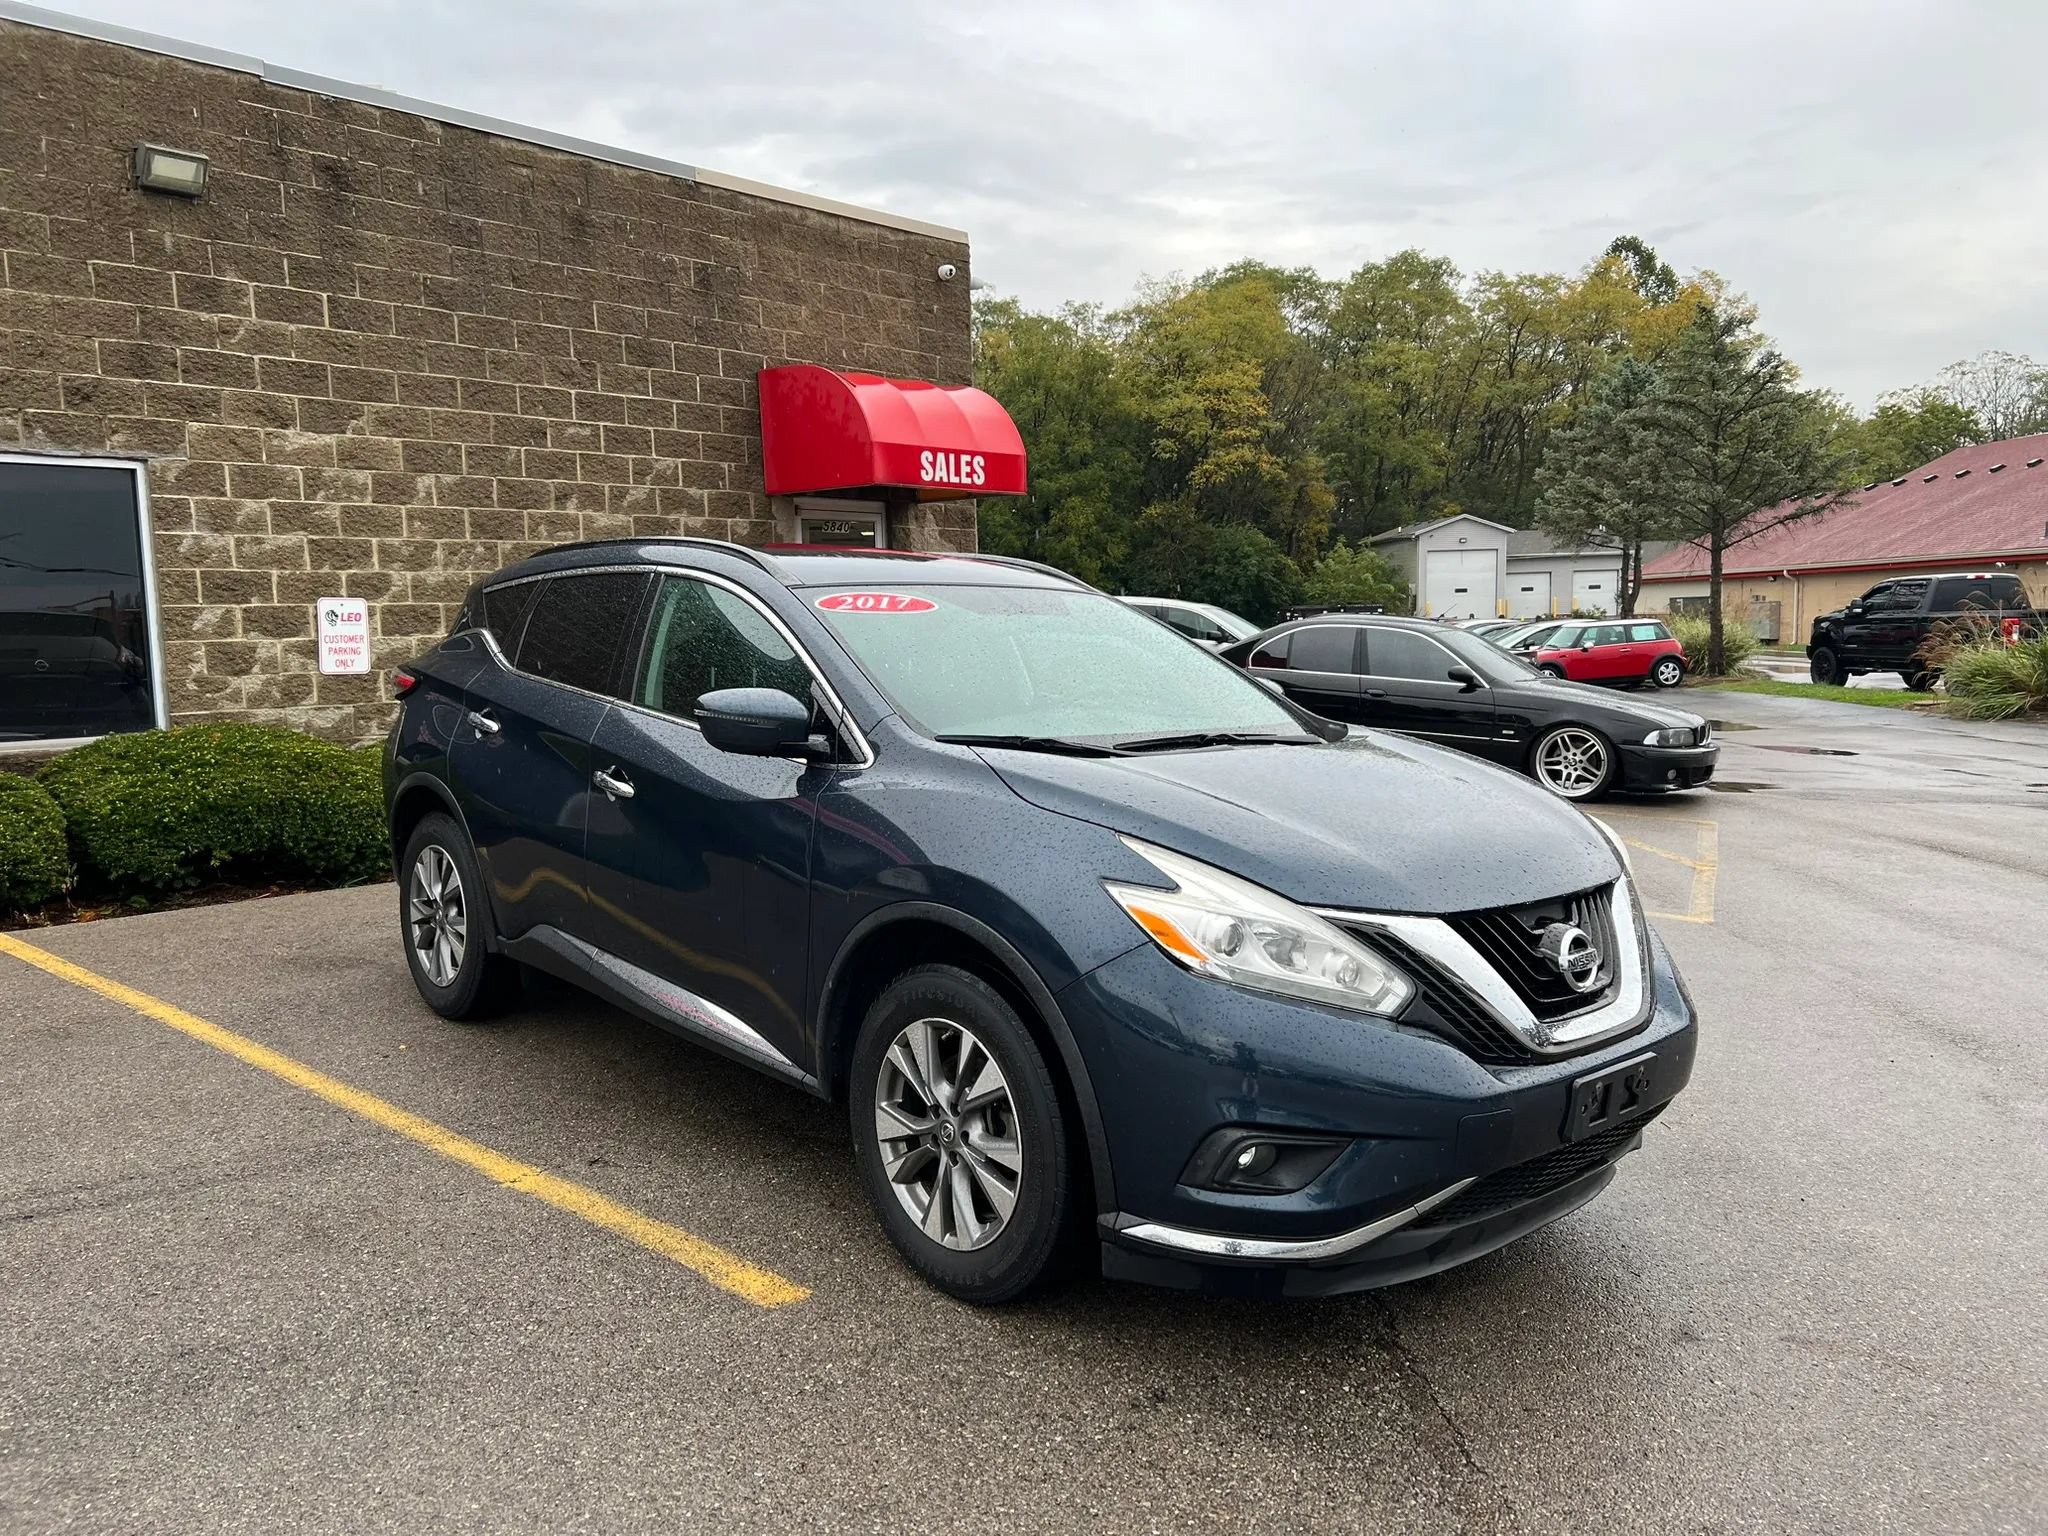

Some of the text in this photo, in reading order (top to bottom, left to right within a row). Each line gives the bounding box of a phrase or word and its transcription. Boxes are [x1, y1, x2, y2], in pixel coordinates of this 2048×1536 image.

[920, 450, 986, 486] SALES
[823, 521, 850, 533] 5840
[836, 596, 913, 610] 2017
[340, 612, 362, 622] LEO
[323, 634, 365, 644] CUSTOMER
[328, 646, 361, 656] PARKING
[335, 658, 355, 668] ONLY
